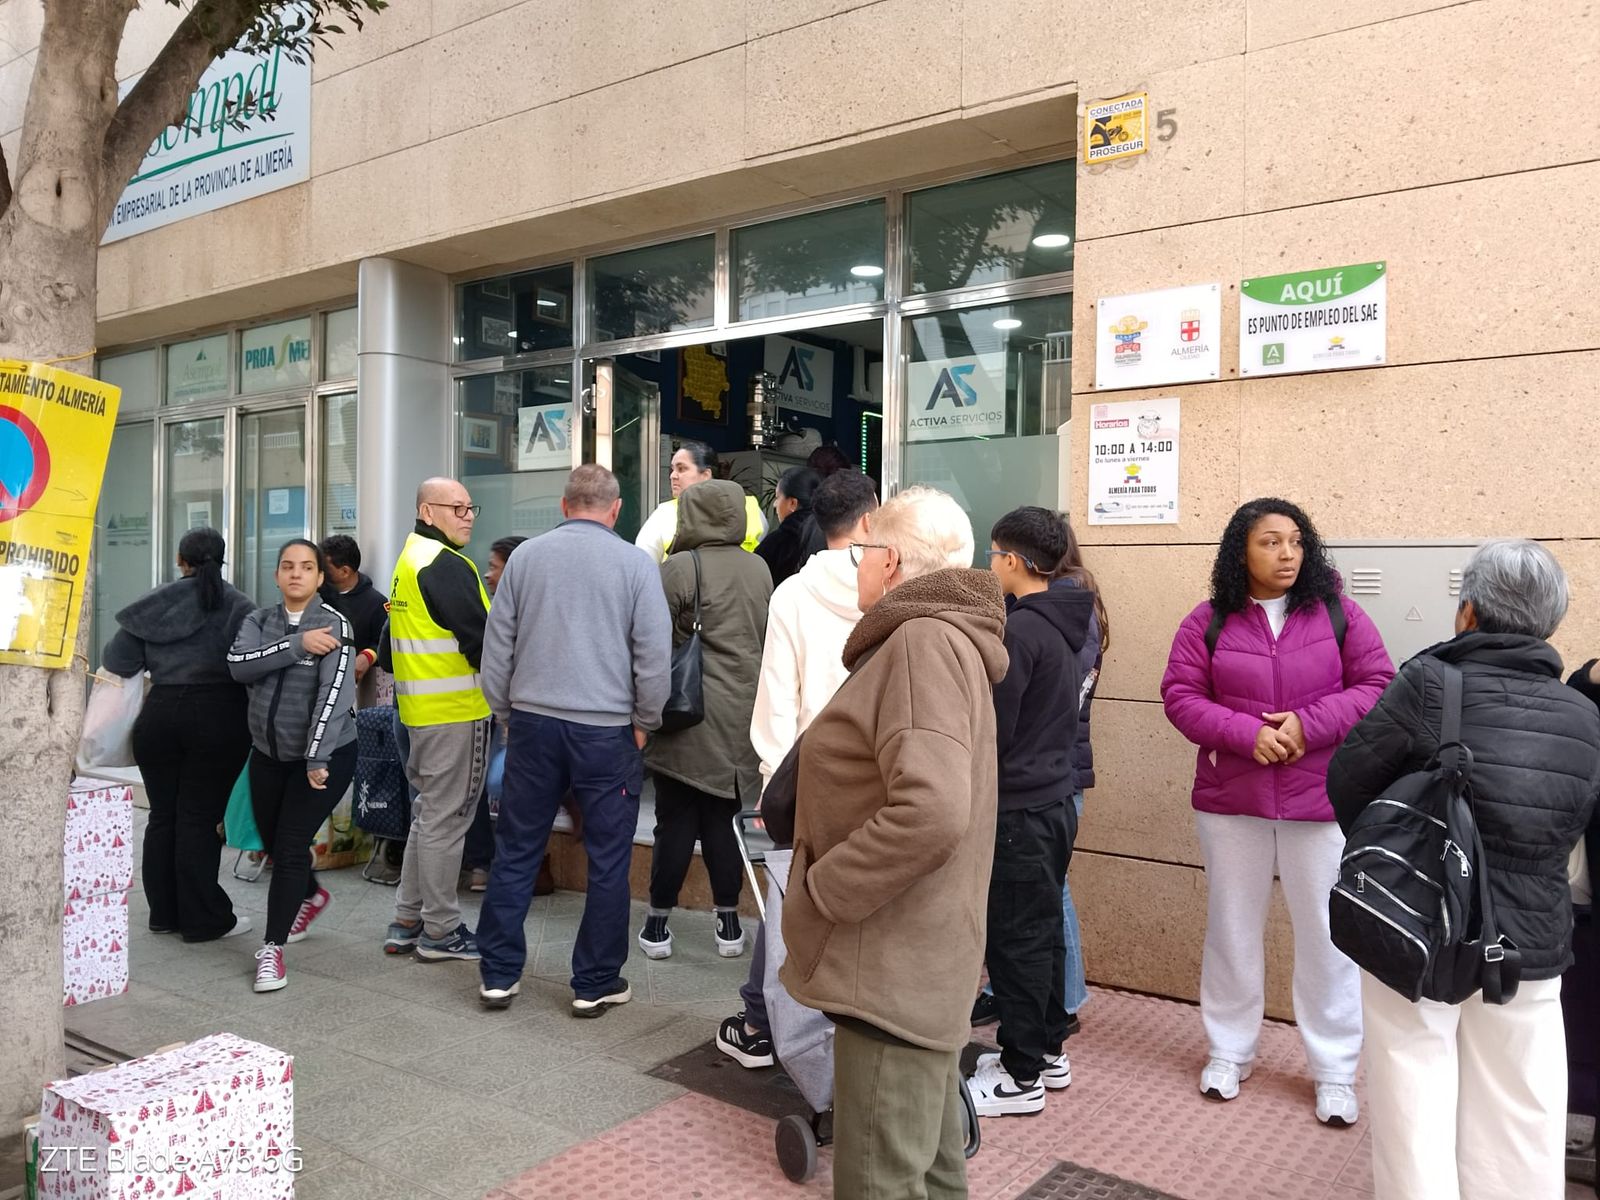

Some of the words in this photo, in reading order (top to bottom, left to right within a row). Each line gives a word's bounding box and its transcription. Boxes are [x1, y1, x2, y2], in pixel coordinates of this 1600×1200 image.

[1090, 98, 1143, 116] CONECTADA
[1157, 108, 1177, 142] 5
[1090, 140, 1143, 158] PROSEGUR
[117, 189, 166, 224] EMPRESARIAL
[169, 184, 179, 207] DE
[182, 180, 192, 203] LA
[195, 164, 237, 198] PROVINCIA
[240, 158, 251, 183] DE
[254, 140, 293, 179] ALMERÍA
[1280, 272, 1343, 302] AQUÍ
[1248, 317, 1258, 334] ES
[1259, 314, 1289, 333] PUNTO
[1291, 312, 1302, 329] DE
[1304, 307, 1340, 328] EMPLEO
[1342, 305, 1359, 323] DEL
[1361, 303, 1378, 321] SAE
[1171, 344, 1209, 356] ALMERÍA
[56, 385, 106, 417] ALMERÍA
[909, 416, 948, 428] ACTIVA
[949, 411, 1003, 425] SERVICIOS
[1095, 420, 1128, 429] Horarios
[1095, 443, 1125, 456] 10:00
[1129, 443, 1135, 454] A
[1141, 440, 1172, 453] 14:00
[1108, 485, 1128, 494] ALMERÍA
[1129, 486, 1140, 494] PARA
[1141, 485, 1156, 493] TODOS
